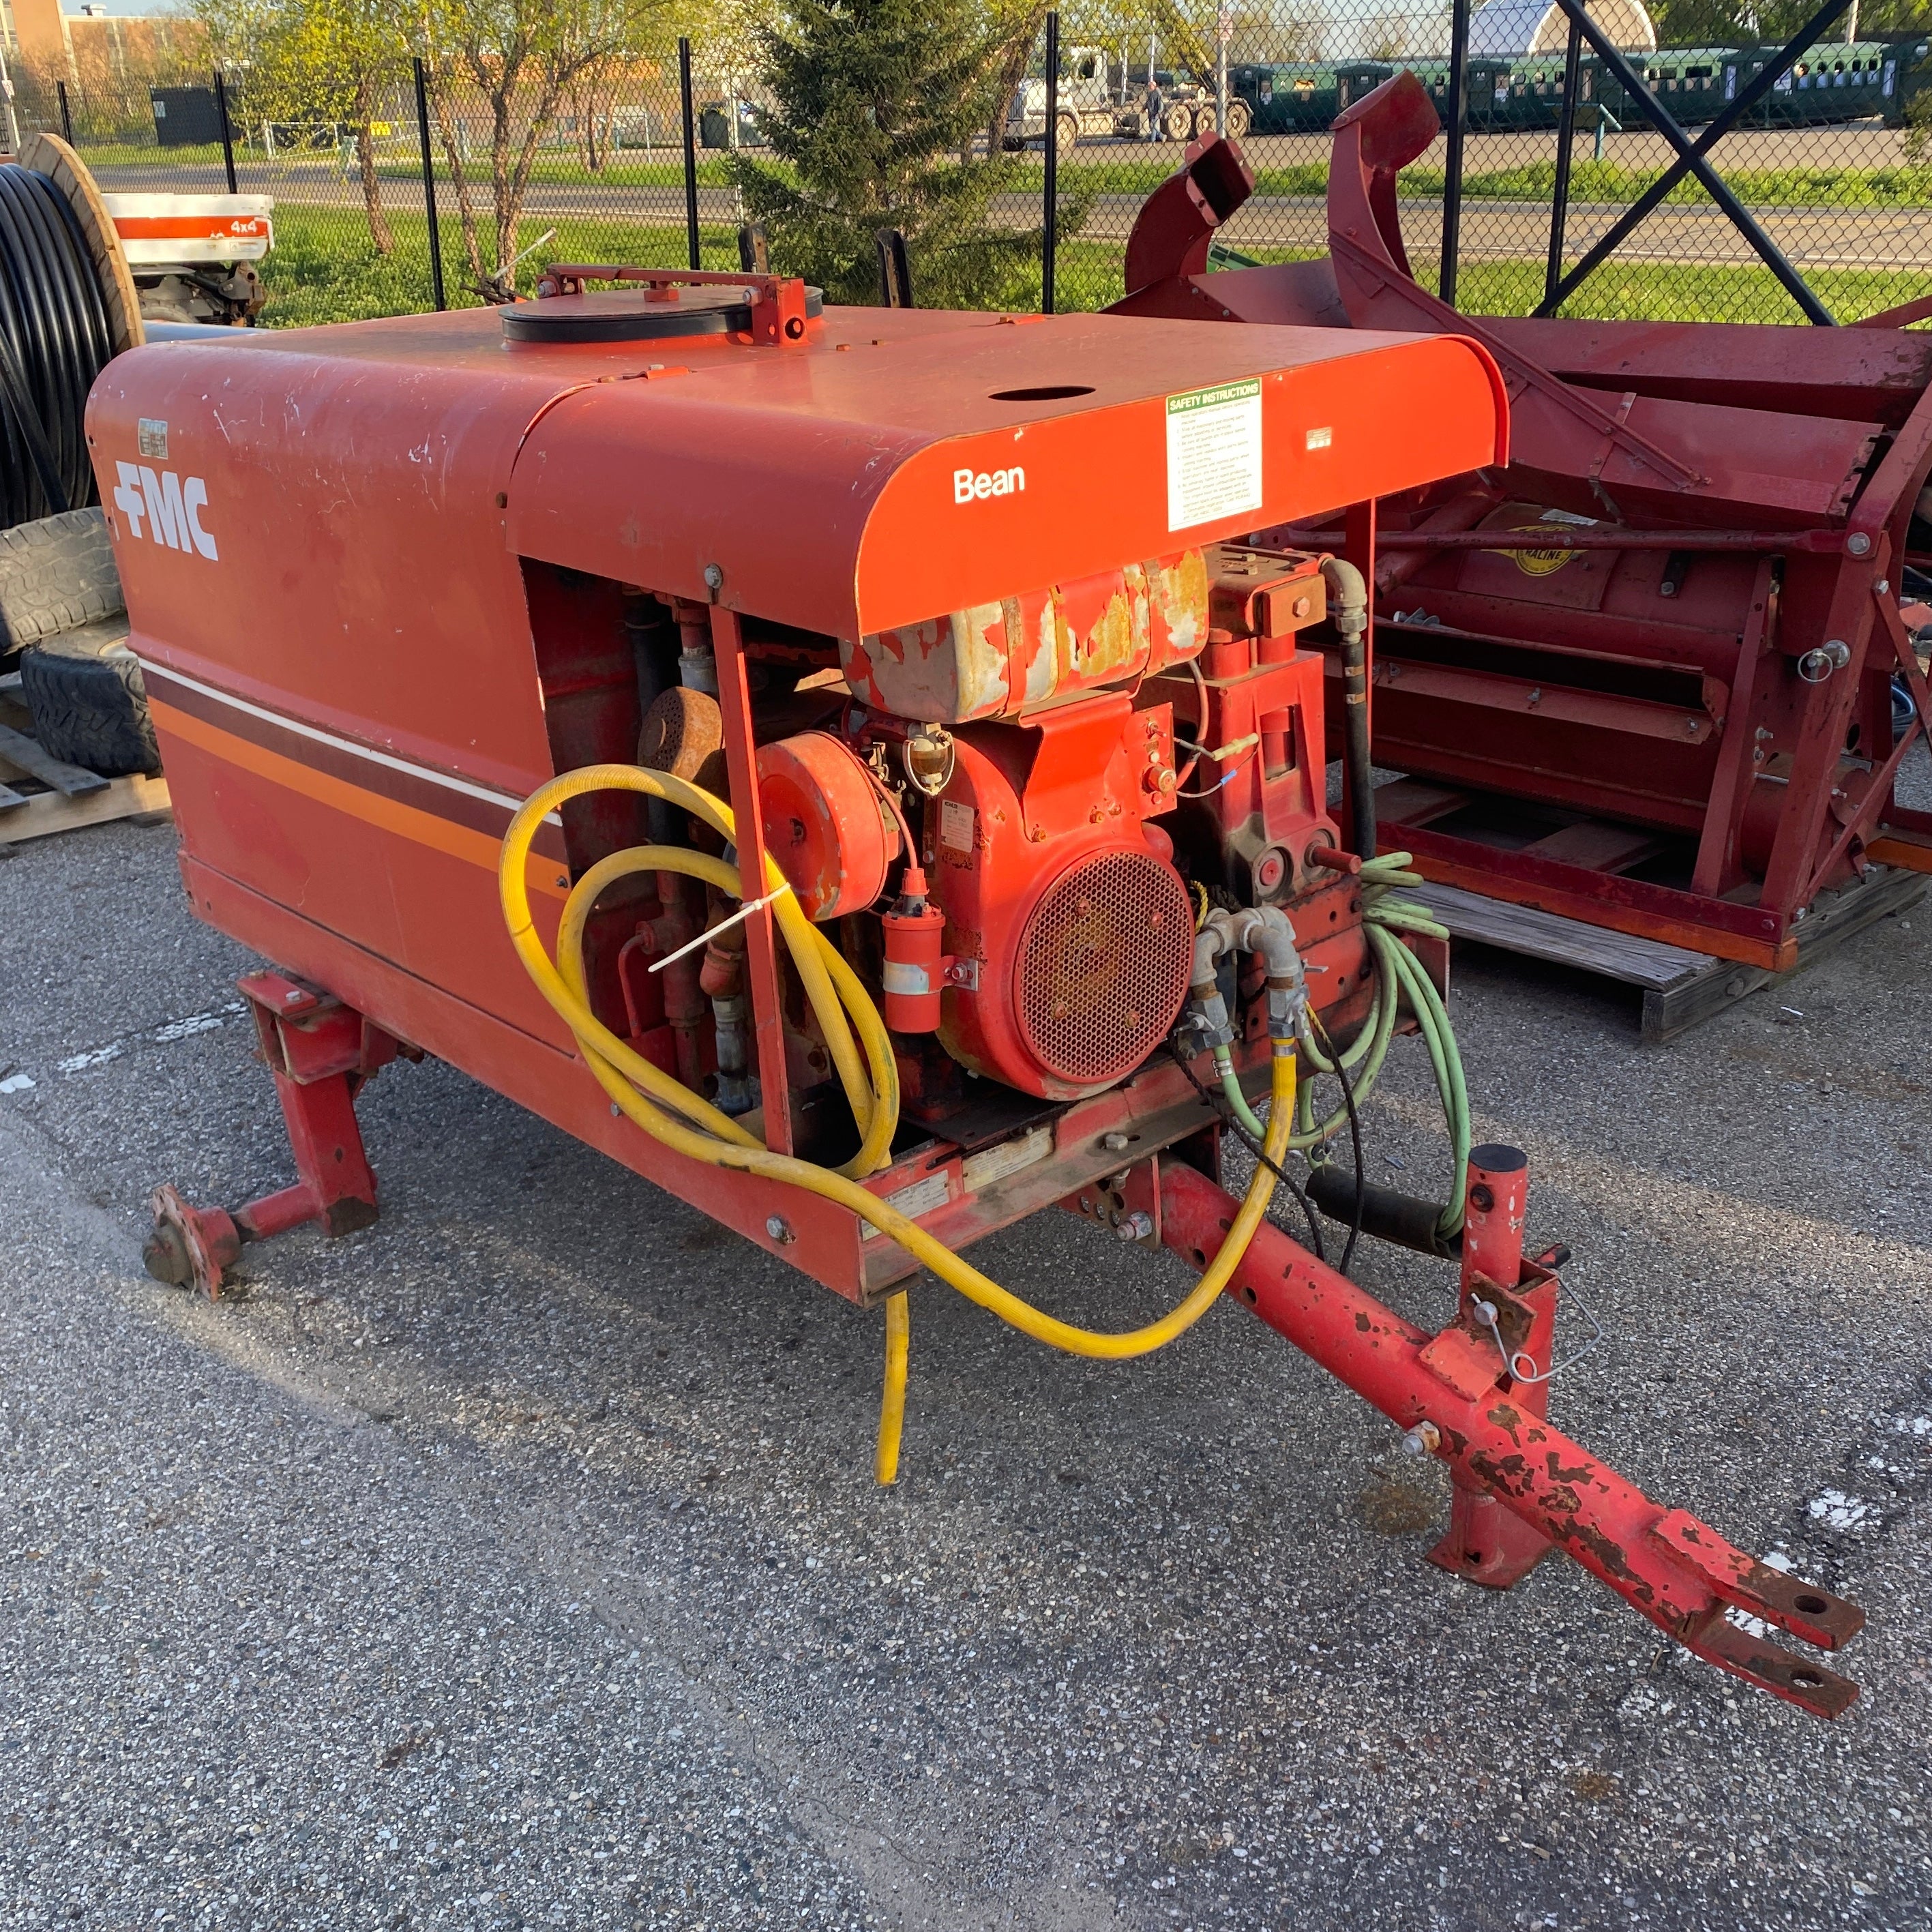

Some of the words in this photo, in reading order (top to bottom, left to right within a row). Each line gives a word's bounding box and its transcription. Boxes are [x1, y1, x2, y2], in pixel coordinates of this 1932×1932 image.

[231, 220, 257, 233] 4x4
[1170, 395, 1201, 411] SAFETY
[1202, 383, 1259, 404] INSTRUCTIONS
[953, 466, 1025, 504] Bean
[114, 460, 218, 562] FMC
